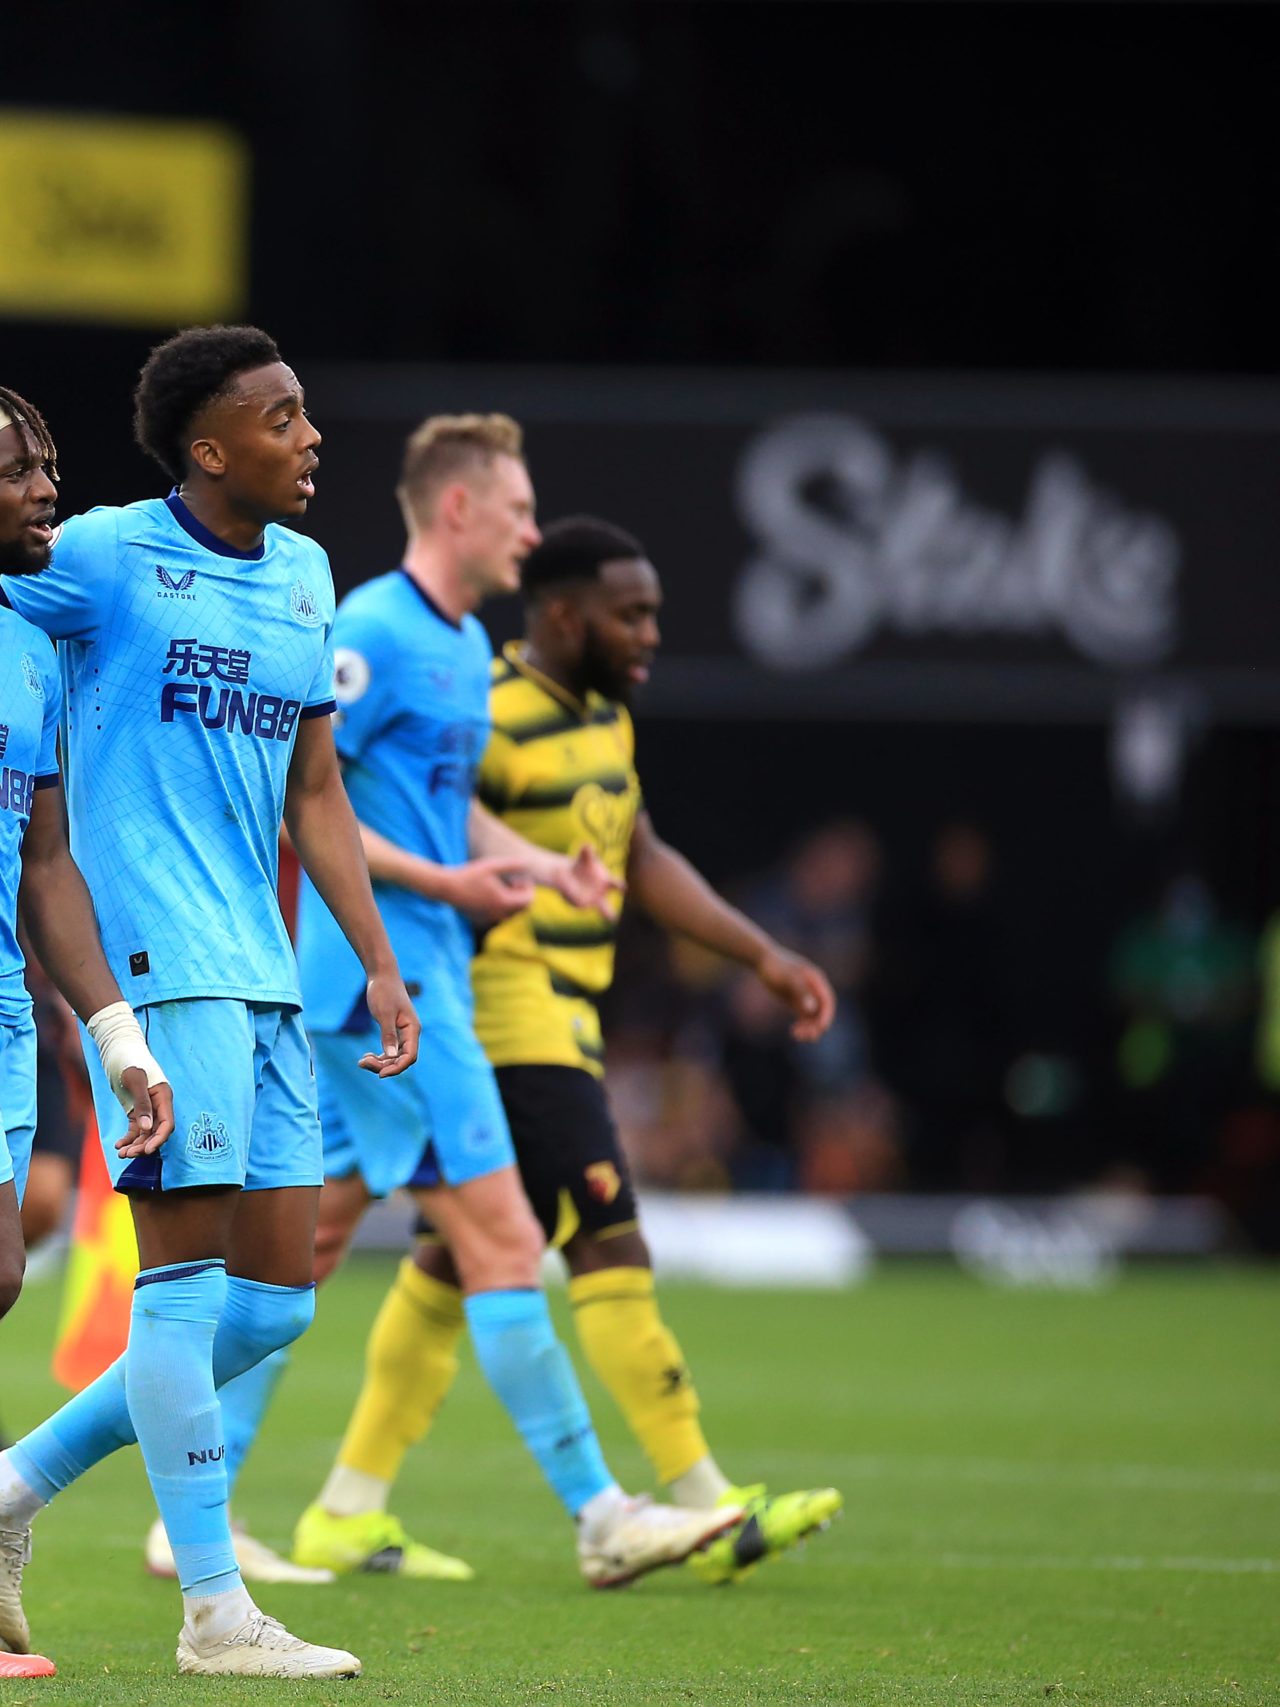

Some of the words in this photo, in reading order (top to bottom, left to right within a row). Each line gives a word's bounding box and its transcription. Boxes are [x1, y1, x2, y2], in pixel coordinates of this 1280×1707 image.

[735, 412, 1180, 670] Stake
[157, 591, 196, 601] CASTORE
[162, 638, 251, 685] 乐天堂
[160, 682, 301, 742] FUN88
